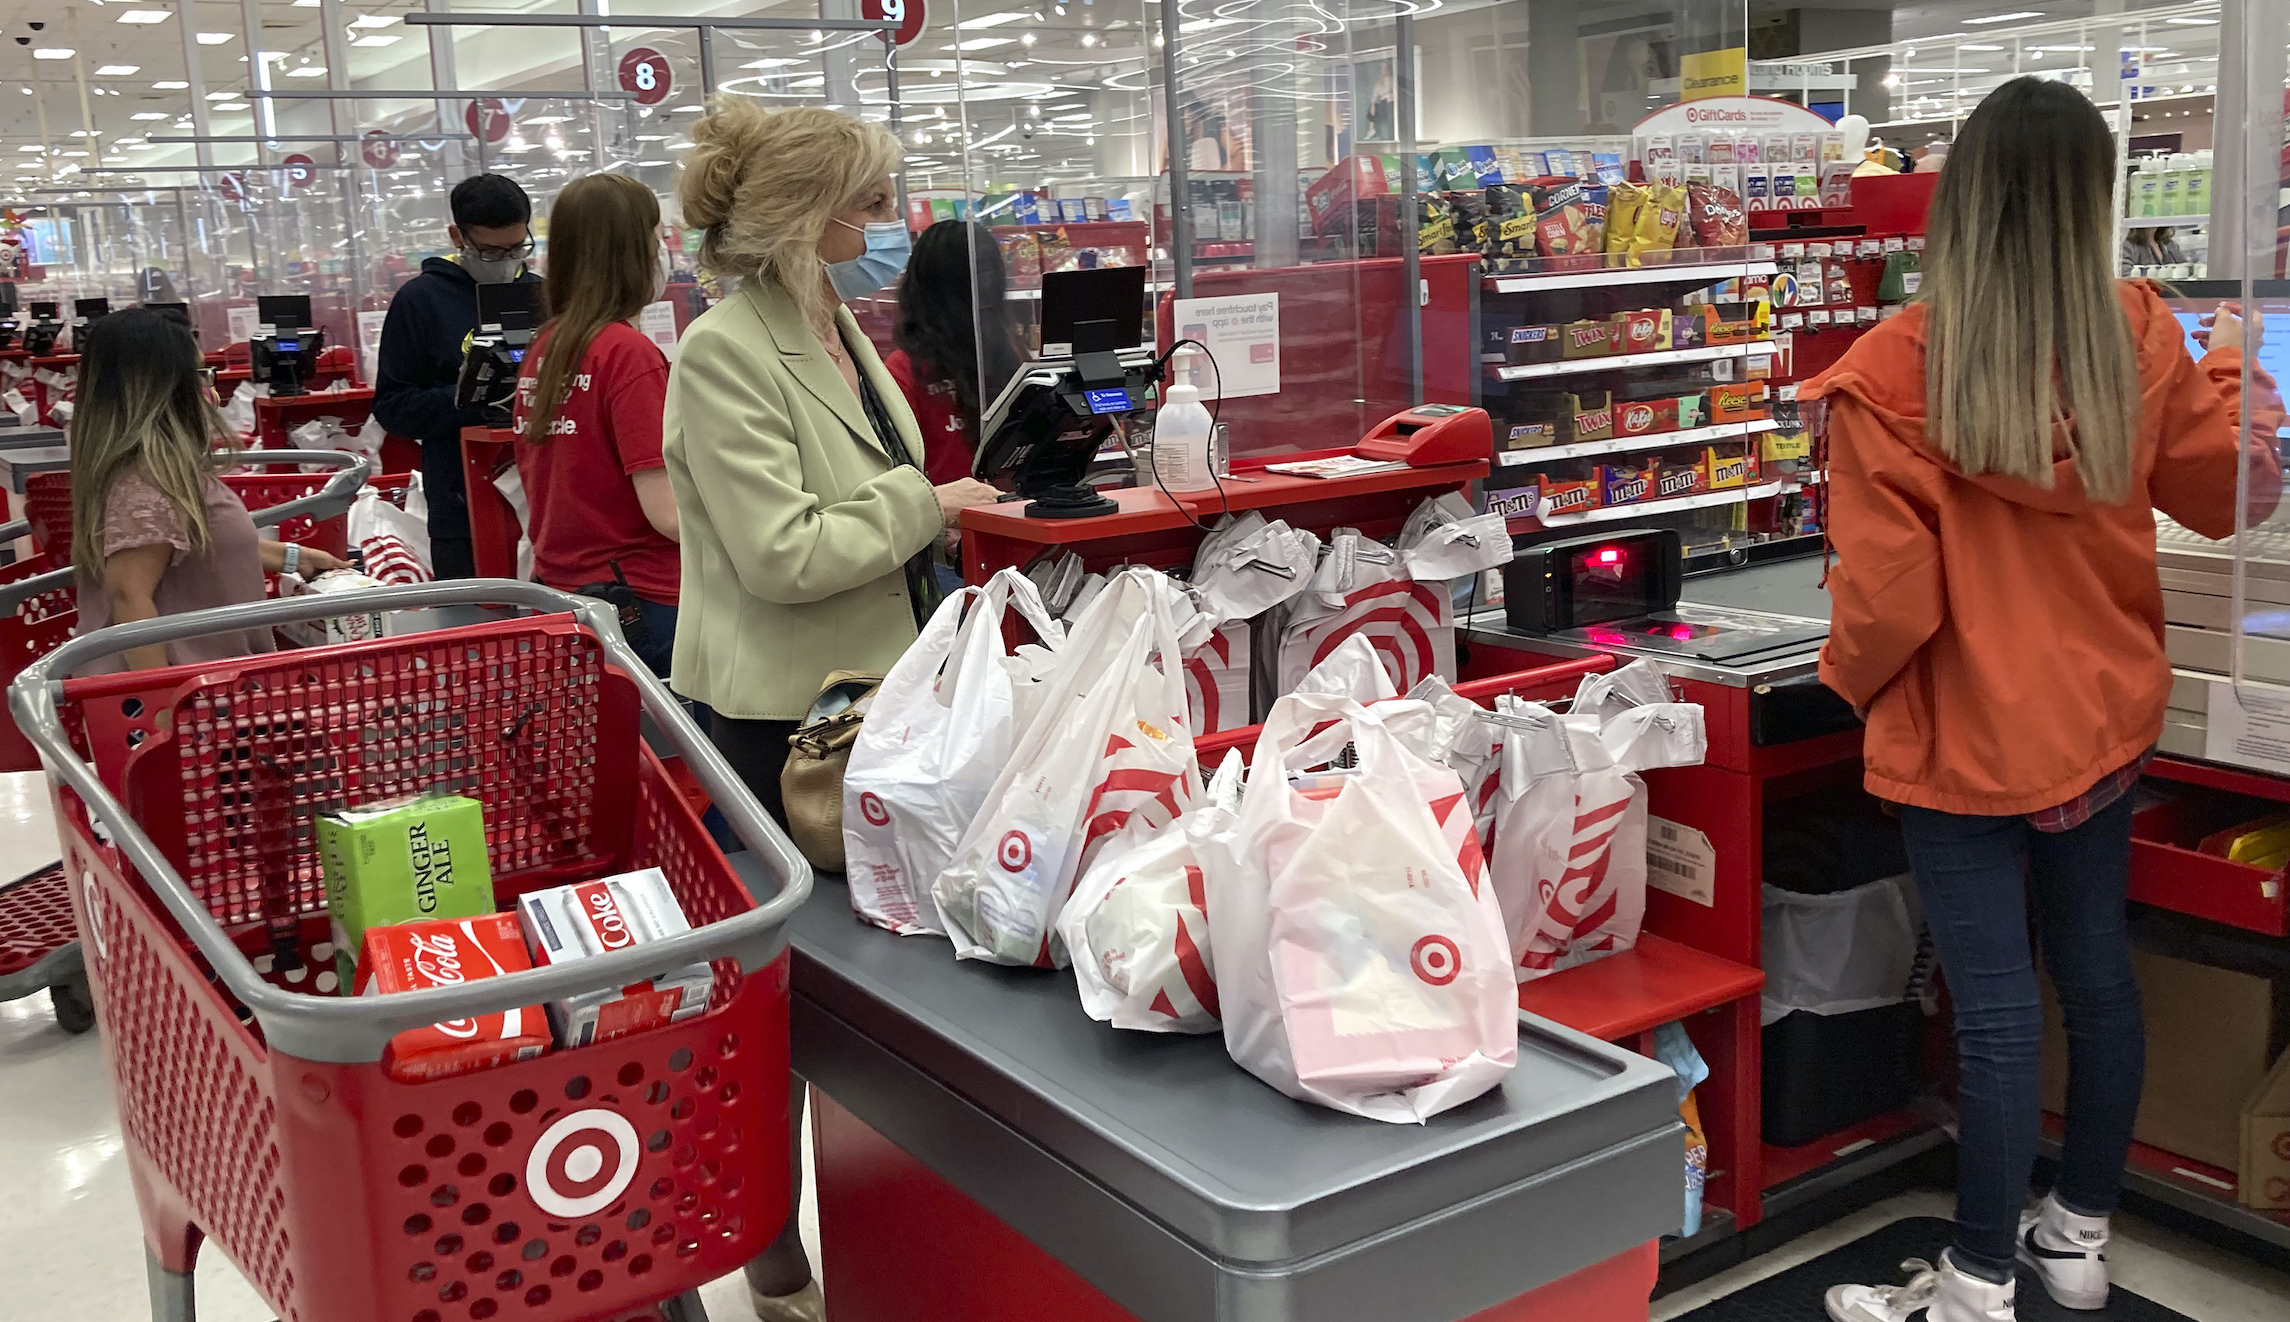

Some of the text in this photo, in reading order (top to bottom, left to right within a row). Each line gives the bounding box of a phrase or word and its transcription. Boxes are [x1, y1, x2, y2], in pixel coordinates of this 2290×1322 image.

[881, 0, 905, 22] 9
[635, 62, 657, 90] 8
[1683, 74, 1739, 90] Clearance
[484, 108, 496, 131] 7
[1699, 109, 1747, 122] GiftCards
[1546, 229, 1566, 239] CORN
[1513, 328, 1546, 342] SNICKERS
[409, 821, 437, 914] GINGER
[431, 839, 455, 886] ALE
[589, 892, 631, 949] Coke
[402, 958, 414, 983] TASTE
[2079, 1229, 2104, 1240] NIKE
